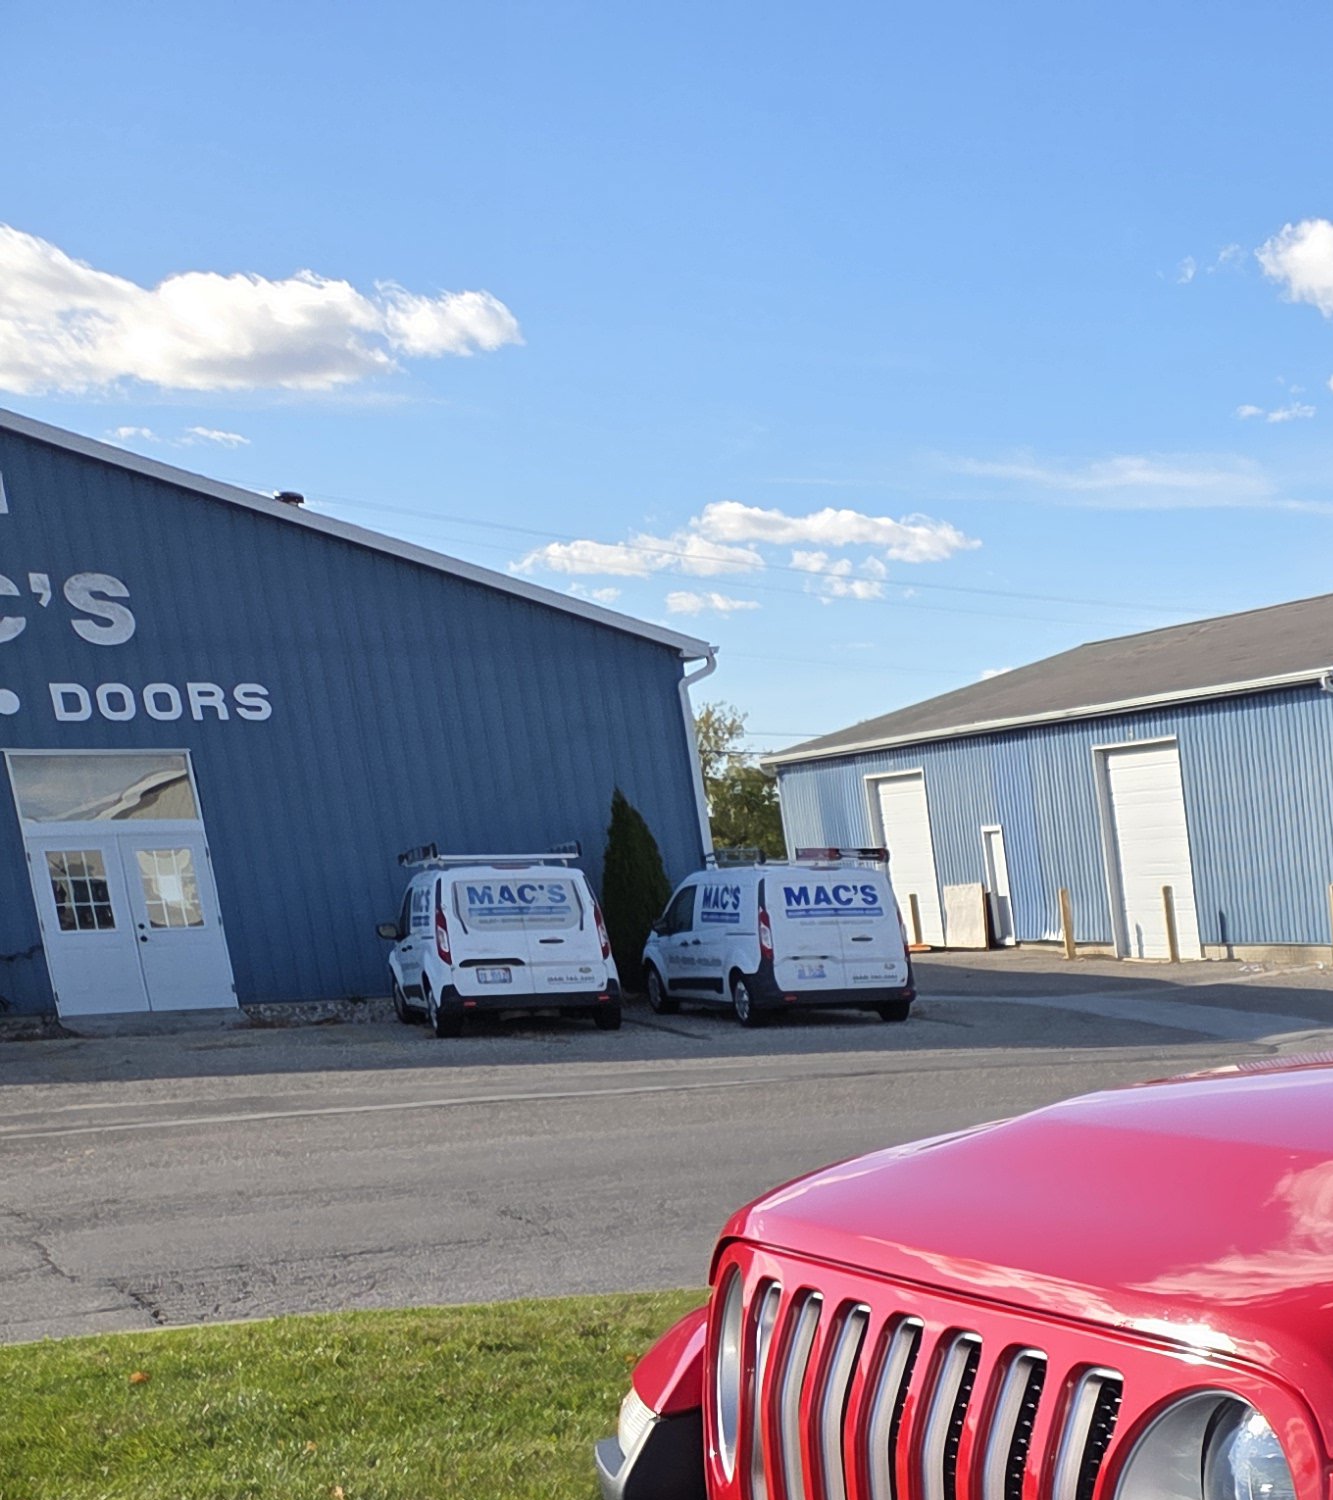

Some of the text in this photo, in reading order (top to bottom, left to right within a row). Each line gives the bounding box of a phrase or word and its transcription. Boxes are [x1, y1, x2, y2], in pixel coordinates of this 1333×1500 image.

[49, 682, 272, 721] DOORS
[466, 884, 567, 905] MAC'S
[702, 885, 741, 910] MAC'S
[783, 885, 878, 906] MAC'S
